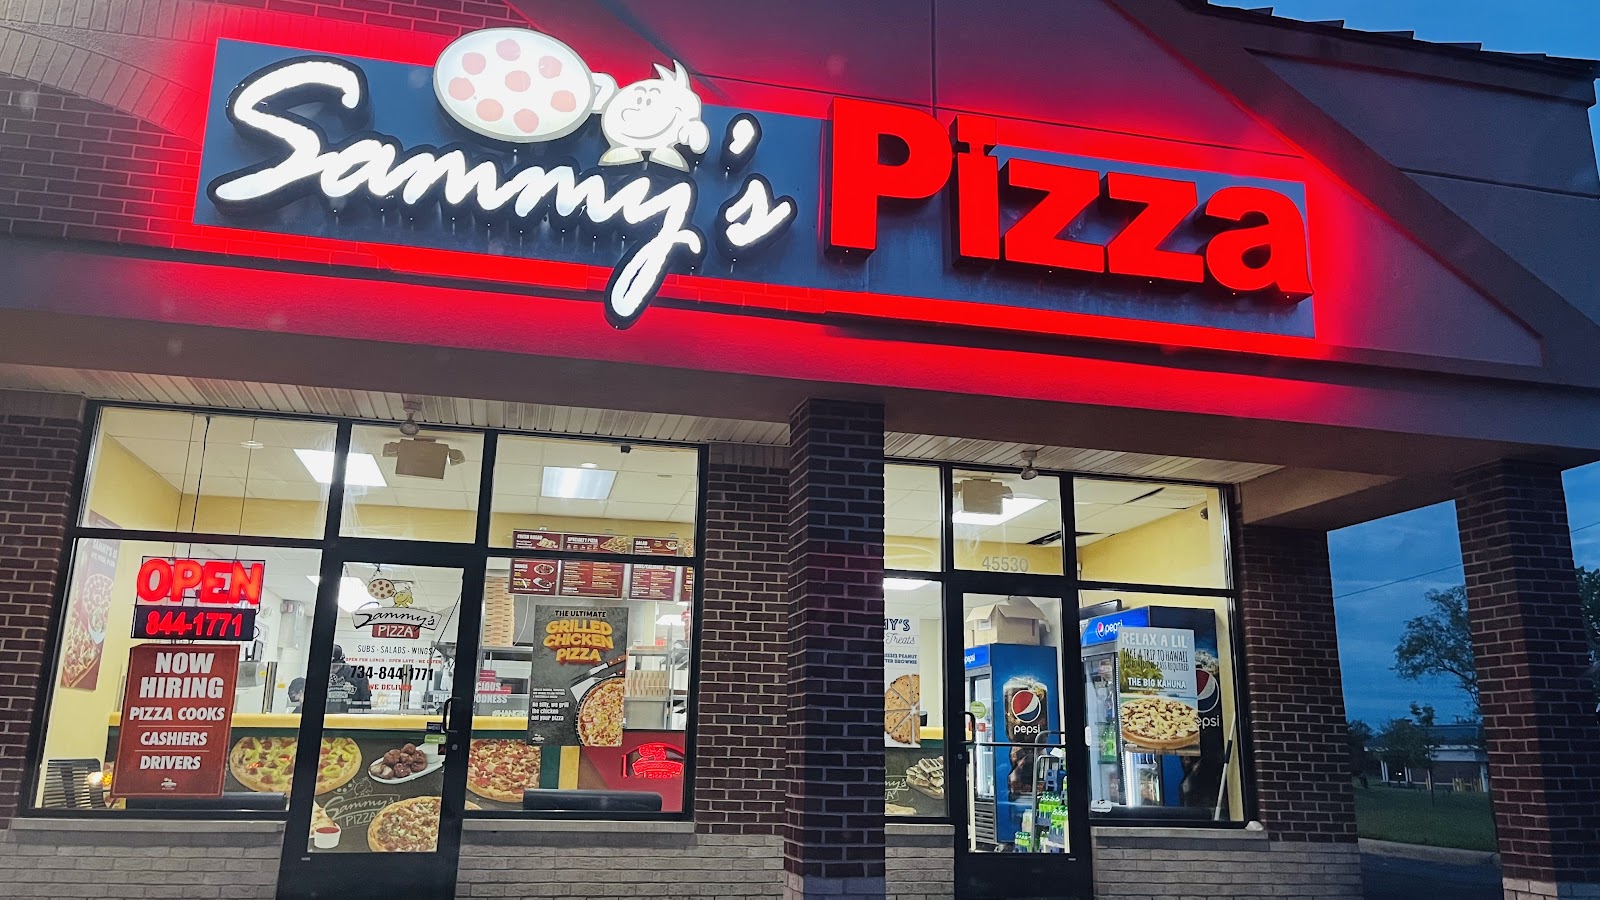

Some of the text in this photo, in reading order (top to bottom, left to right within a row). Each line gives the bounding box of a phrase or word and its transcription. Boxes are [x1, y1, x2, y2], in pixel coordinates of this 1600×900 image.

[212, 60, 1314, 318] Sammy's Pizza
[982, 555, 1029, 572] 45530
[136, 558, 263, 604] OPEN
[354, 602, 435, 630] Sammy's
[570, 610, 606, 618] ULTIMATE
[145, 610, 243, 638] 844-1771
[378, 625, 414, 638] PIZZA
[545, 619, 613, 636] GRILLED
[542, 633, 614, 650] CHICKEN
[886, 632, 916, 644] Treats
[1122, 632, 1158, 646] RELAX
[1160, 634, 1168, 647] A
[358, 644, 433, 656] SUBS SALADS WINGS
[554, 646, 602, 664] PIZZA
[1122, 648, 1136, 660] TAKE
[1144, 648, 1156, 661] TRIP
[1157, 650, 1165, 662] TO
[1166, 650, 1188, 662] HAWAII
[154, 652, 215, 674] NOW
[1168, 662, 1190, 672] REQUIRED
[350, 665, 434, 680] 734-844-1771
[139, 676, 225, 698] HIRING
[1128, 678, 1187, 689] THE BIG KAHUNA
[129, 706, 226, 721] PIZZA COOKS
[1014, 723, 1041, 735] pepsi
[1198, 716, 1220, 730] epsi
[140, 732, 208, 746] CASHIERS
[140, 756, 202, 770] DRIVERS
[324, 796, 395, 820] Sammy's
[345, 812, 376, 826] PIZZA
